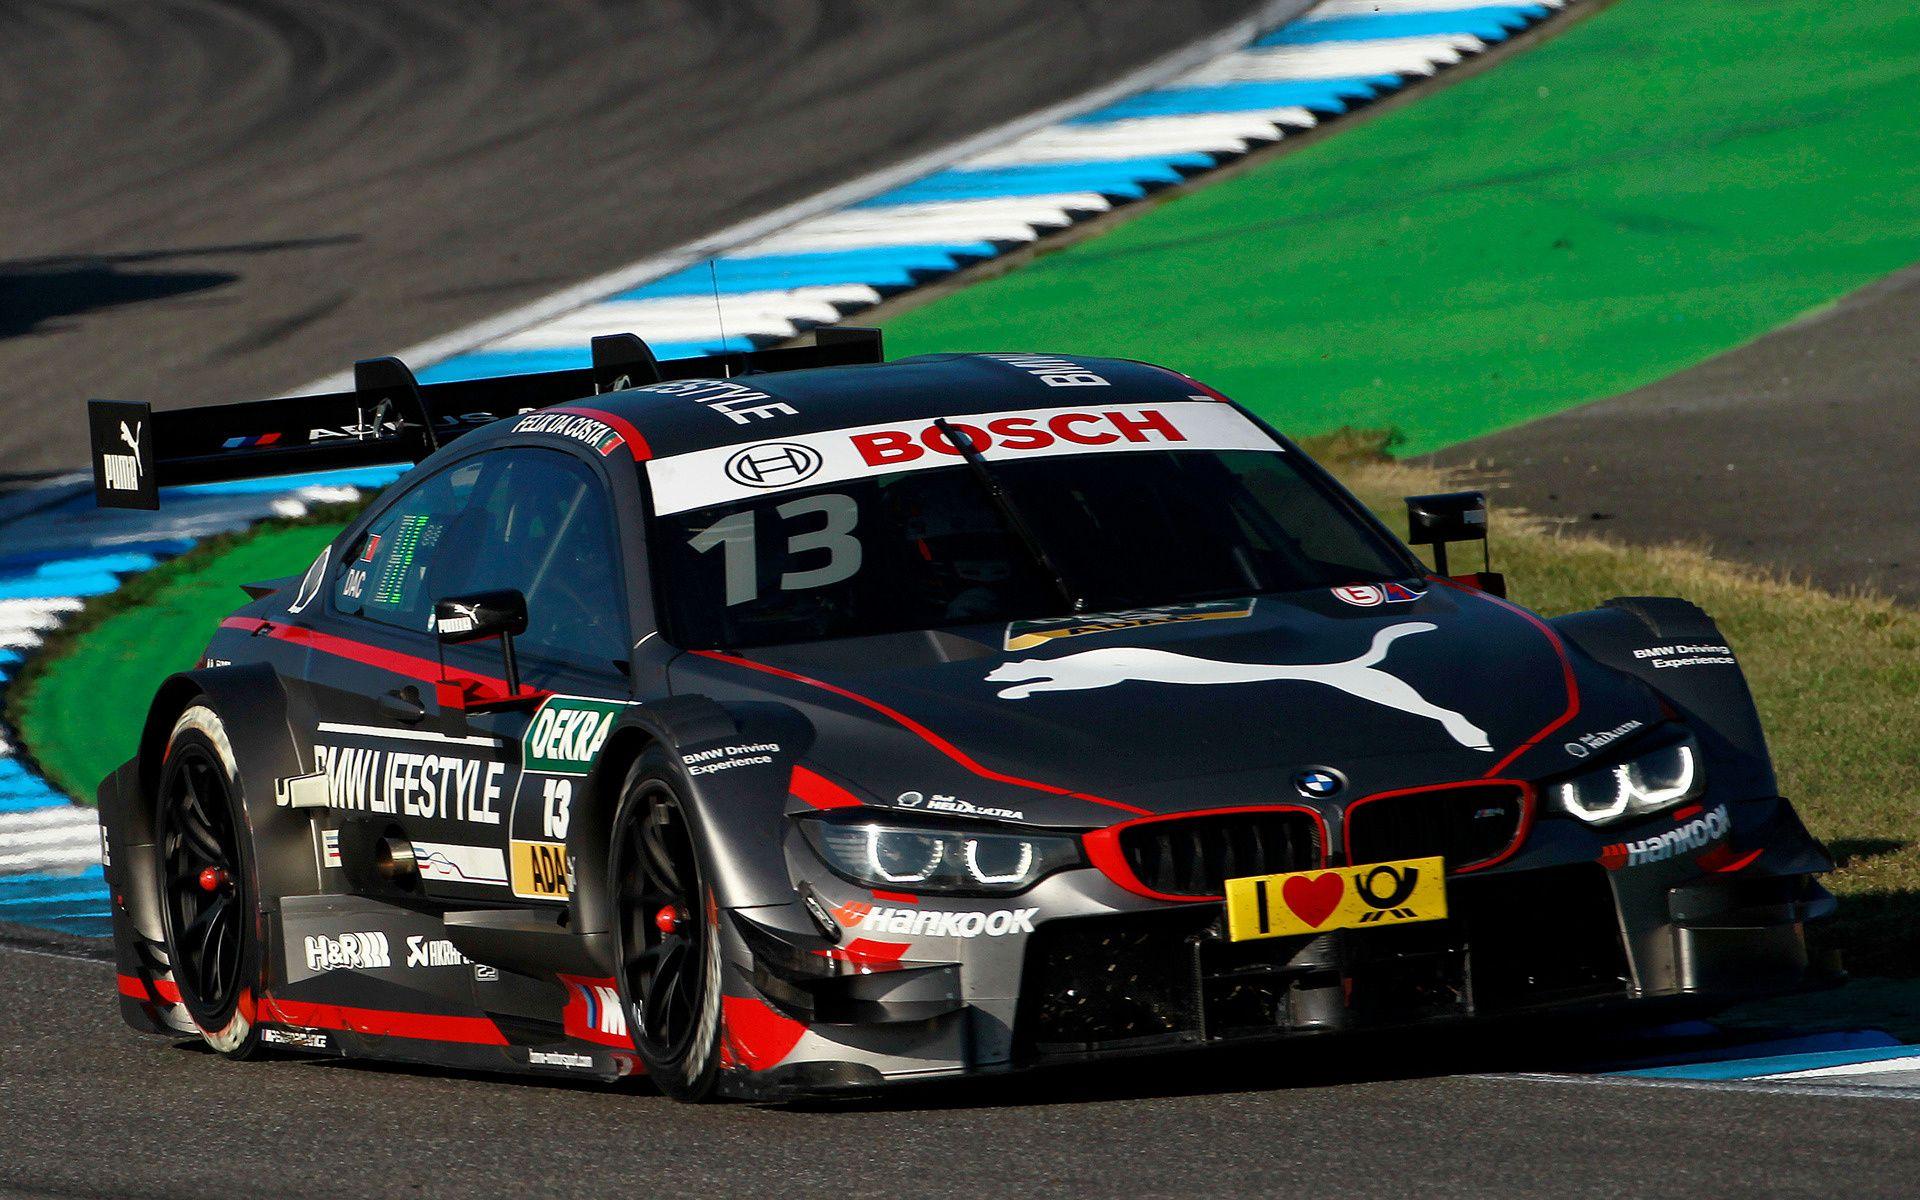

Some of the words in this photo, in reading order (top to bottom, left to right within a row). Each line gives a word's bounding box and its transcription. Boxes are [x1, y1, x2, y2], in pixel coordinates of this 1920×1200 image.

[565, 416, 612, 447] COSTA
[850, 409, 1188, 467] BOSCH
[687, 493, 863, 607] 13
[342, 567, 367, 598] DAC
[1633, 646, 1675, 659] BMW
[1676, 644, 1731, 655] Driving
[1652, 655, 1736, 669] Experience
[531, 707, 615, 762] DEKRA
[682, 748, 724, 764] BMW
[724, 743, 781, 756] Driving
[687, 755, 773, 776] Experience
[369, 751, 506, 825] LIFESTYLE
[542, 777, 573, 840] 13
[304, 932, 364, 972] H&R
